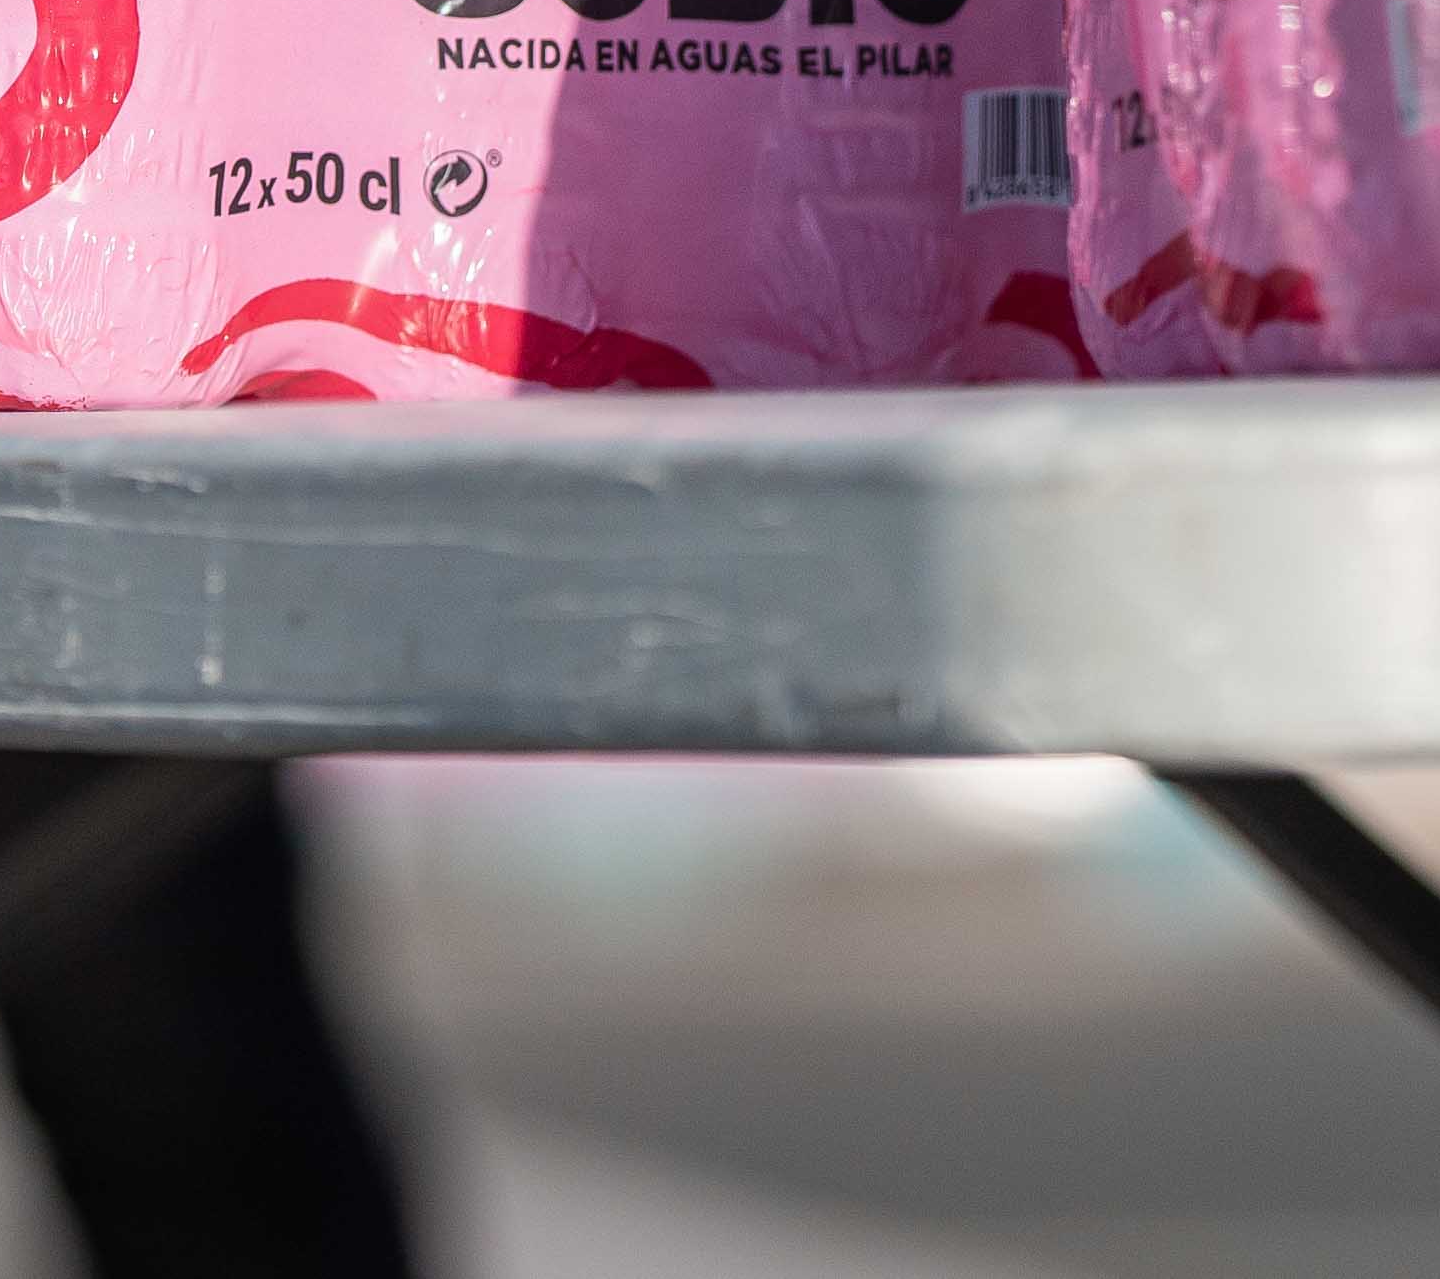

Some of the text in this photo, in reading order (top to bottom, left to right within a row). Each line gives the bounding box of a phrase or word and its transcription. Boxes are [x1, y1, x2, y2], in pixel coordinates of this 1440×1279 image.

[436, 37, 955, 78] NACIDA EN AGUAS EL PILAR
[358, 156, 401, 216] cl
